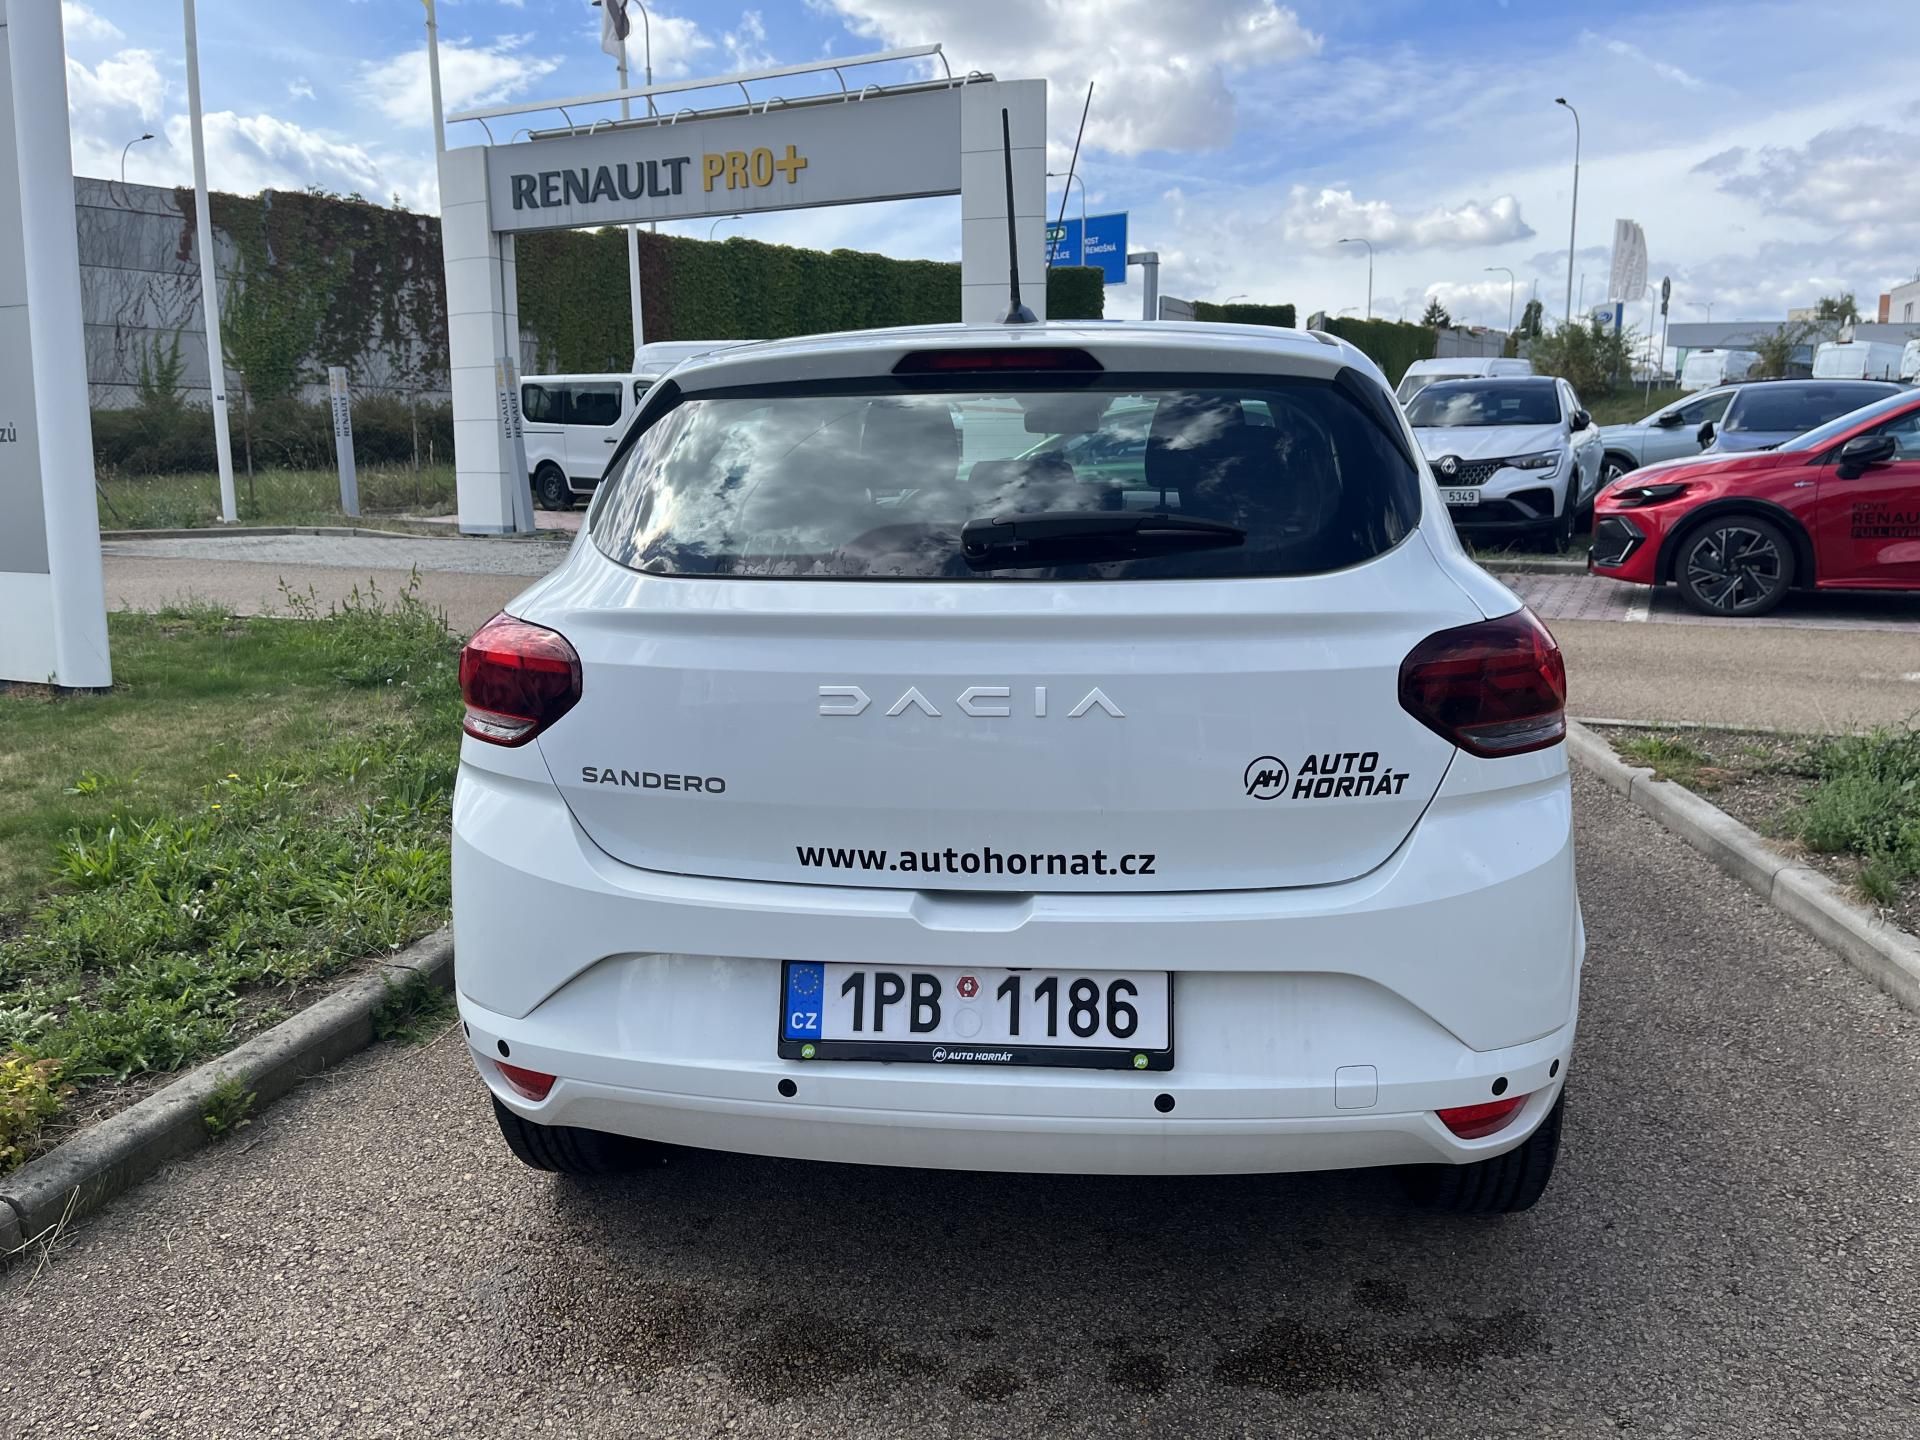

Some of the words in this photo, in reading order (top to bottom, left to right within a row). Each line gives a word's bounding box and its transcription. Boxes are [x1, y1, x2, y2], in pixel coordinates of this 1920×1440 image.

[510, 156, 690, 210] RENAULT
[703, 145, 807, 192] PRO+
[340, 397, 350, 437] RENAULT
[500, 392, 511, 439] RENAULT
[510, 392, 521, 438] RENAULT
[1449, 491, 1474, 501] 5349
[818, 685, 1126, 718] DACIA
[582, 766, 726, 794] SANDERO
[1298, 752, 1379, 776] AUTO
[796, 845, 1156, 876] www.autohornat.cz
[791, 1012, 817, 1030] CZ
[841, 972, 942, 1033] 1PB
[997, 975, 1139, 1039] 1186
[948, 1051, 973, 1061] AUTO
